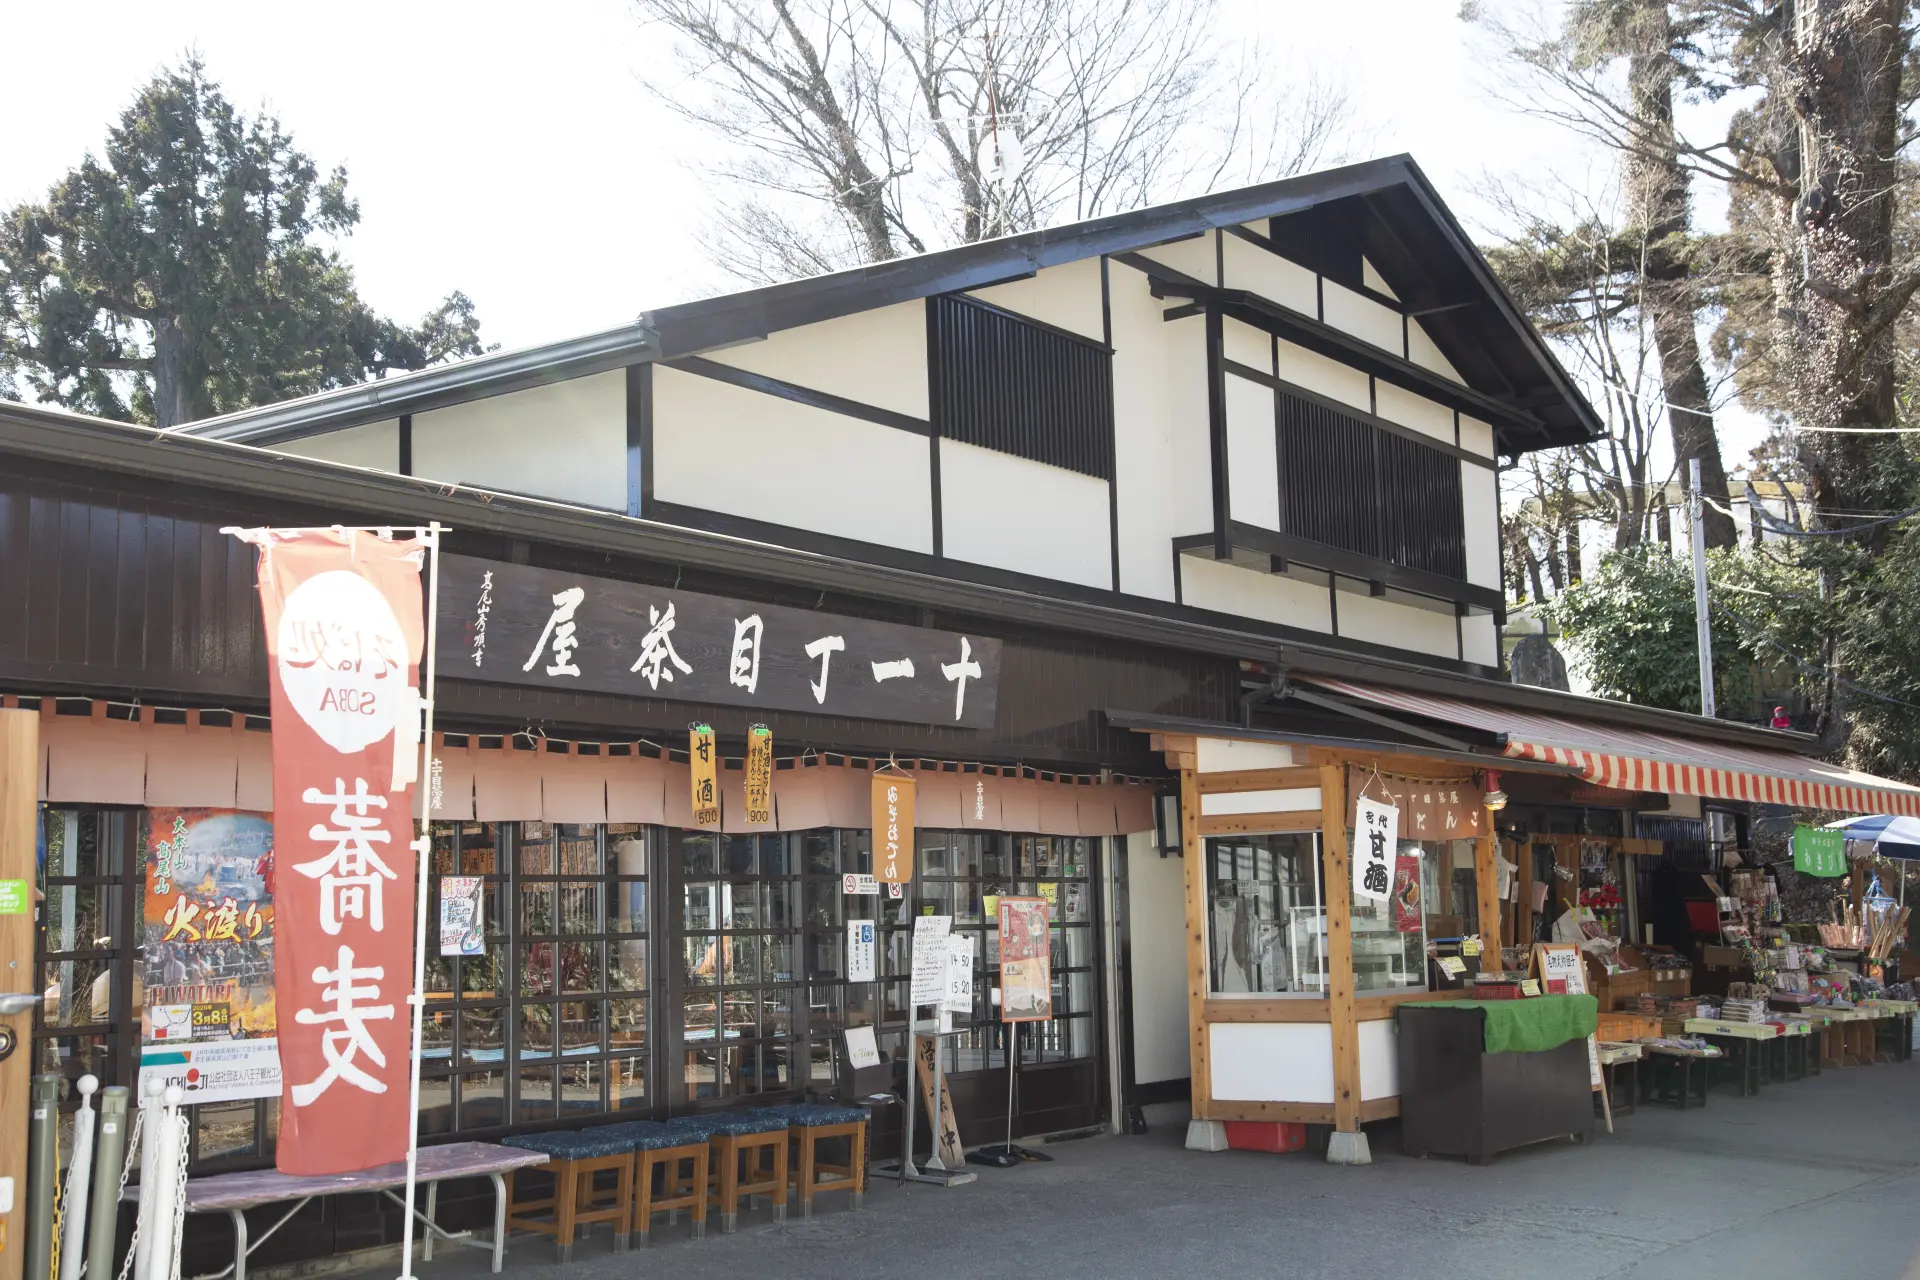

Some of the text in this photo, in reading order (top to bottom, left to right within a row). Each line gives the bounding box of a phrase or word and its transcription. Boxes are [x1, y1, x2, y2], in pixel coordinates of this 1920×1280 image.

[430, 758, 443, 810] 十一丁目茶屋
[696, 734, 712, 803] 甘酒
[762, 736, 772, 801] 甘酒セット
[699, 810, 717, 824] 500
[750, 810, 768, 822] 900
[1381, 787, 1459, 804] 十一丁目茶屋
[1417, 811, 1479, 830] だんご
[153, 840, 171, 894] 高尾山
[172, 816, 188, 869] 大本山
[1364, 829, 1388, 894] 甘酒
[162, 895, 275, 942] 火渡り
